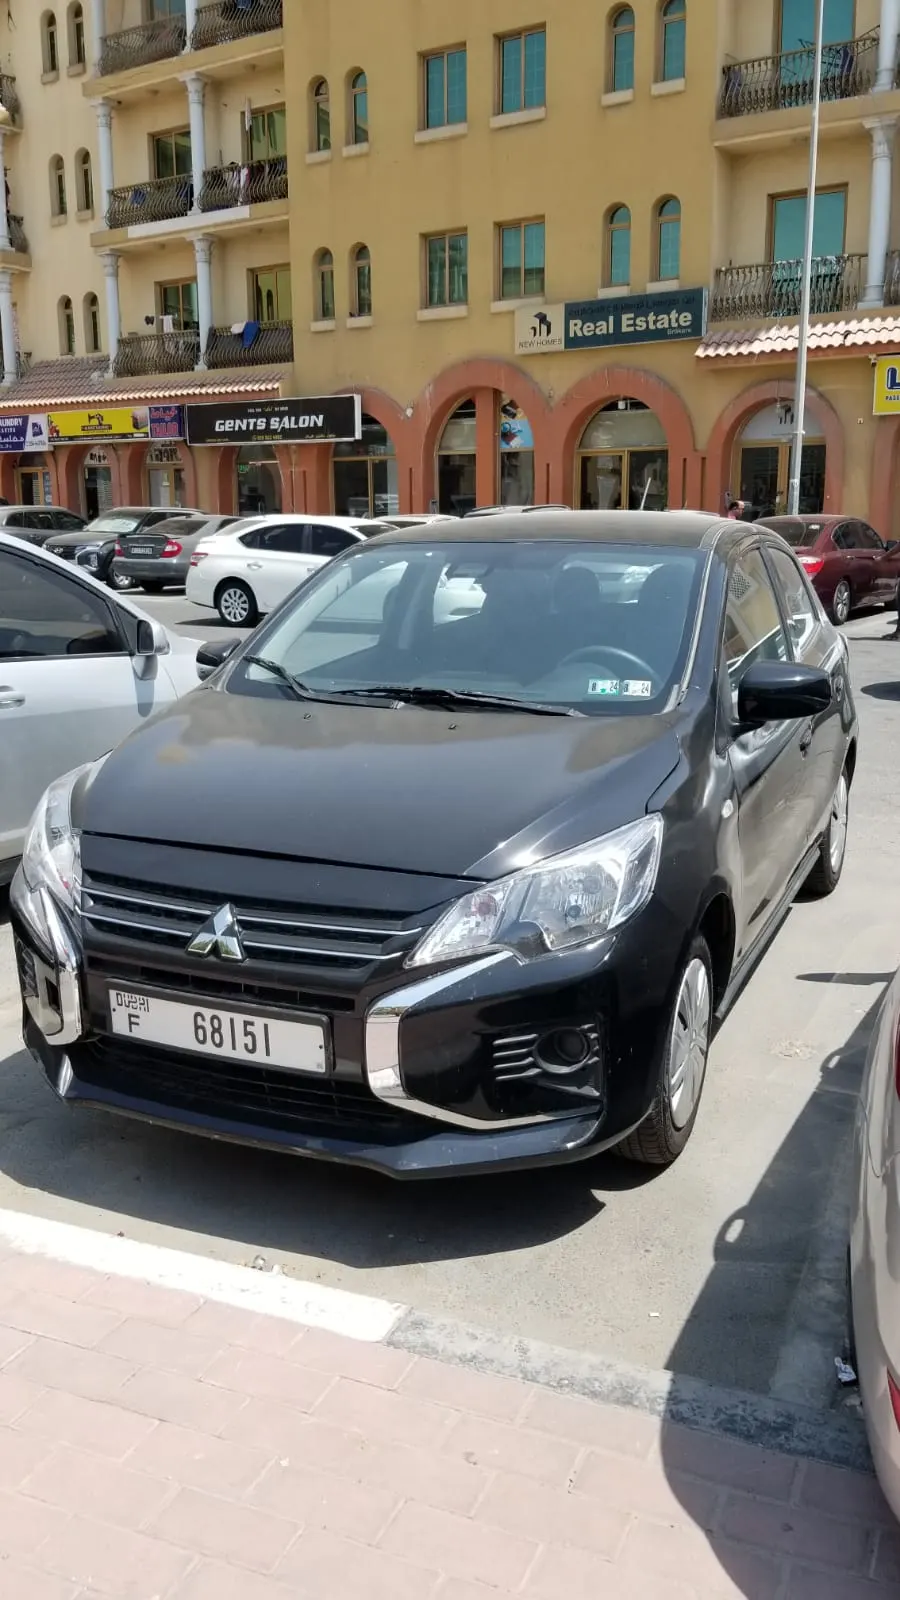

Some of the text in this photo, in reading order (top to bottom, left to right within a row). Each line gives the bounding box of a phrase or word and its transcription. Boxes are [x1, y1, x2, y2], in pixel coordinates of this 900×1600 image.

[568, 308, 692, 338] Real Estate
[518, 337, 562, 349] NEW HOMES
[270, 414, 324, 433] SALON
[127, 1012, 141, 1034] F
[193, 1010, 271, 1057] 68151
